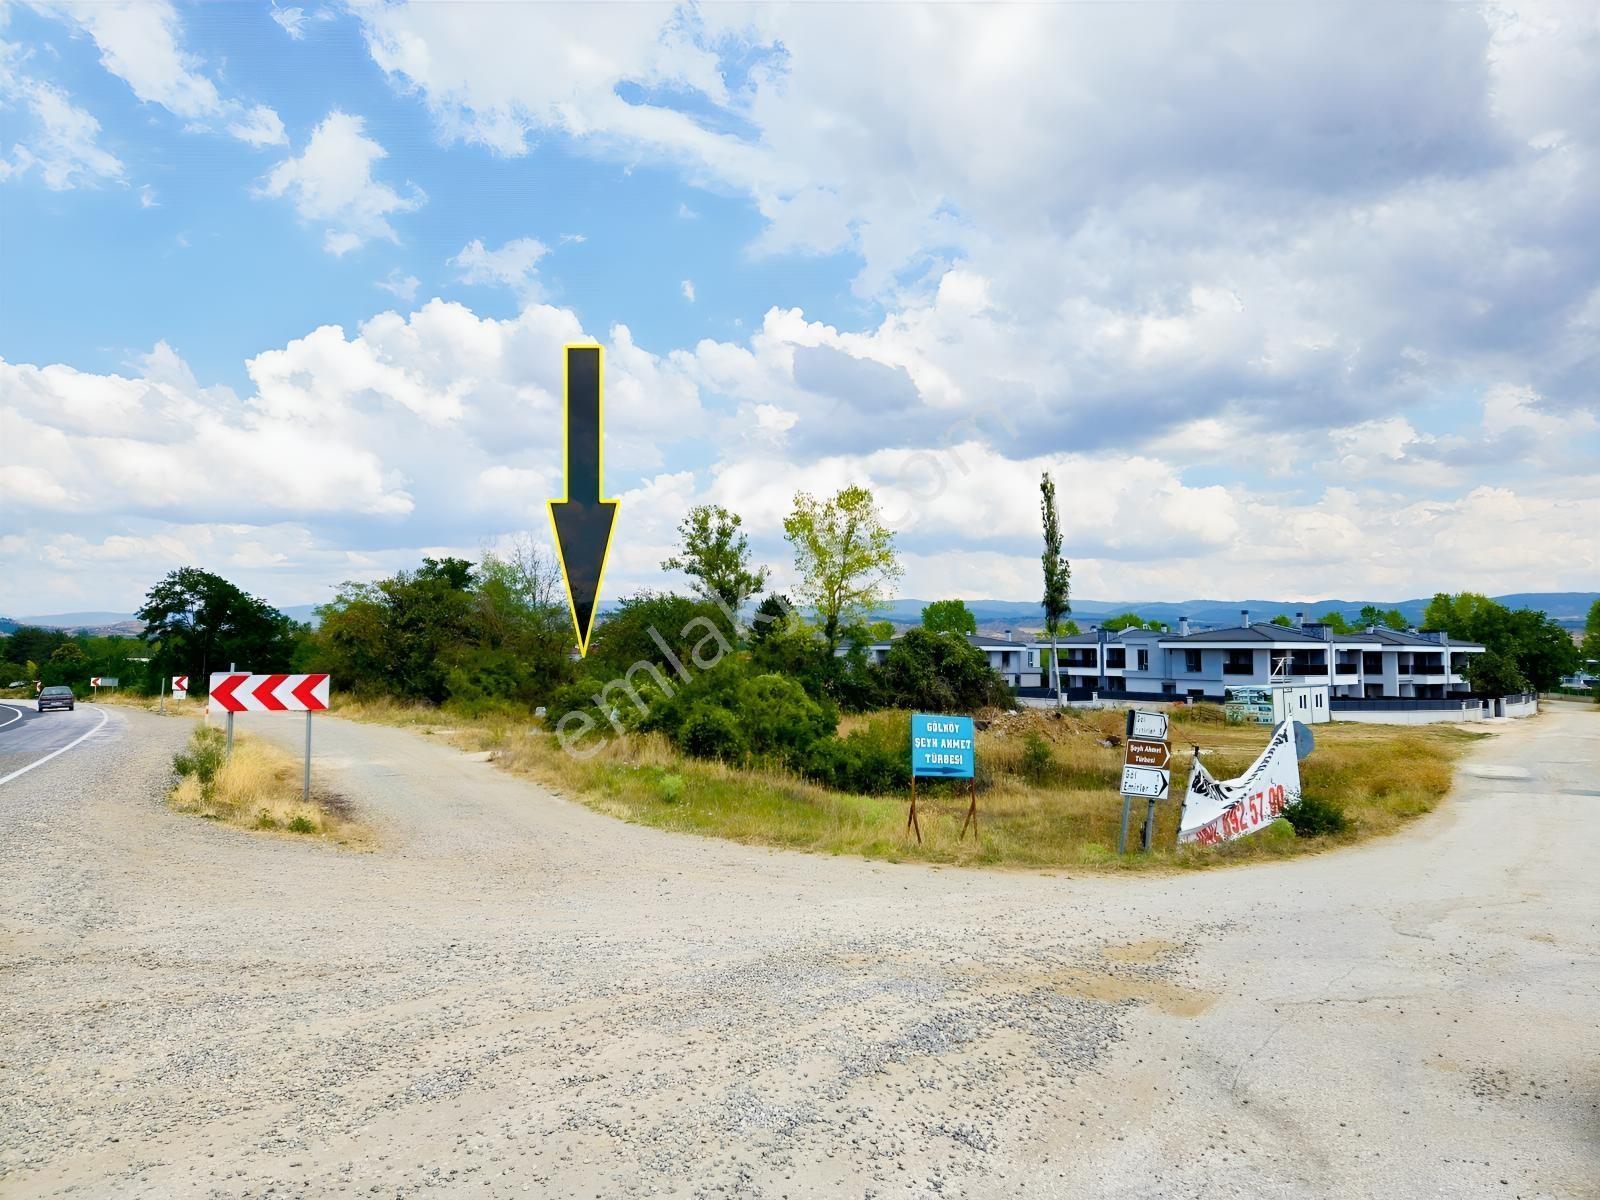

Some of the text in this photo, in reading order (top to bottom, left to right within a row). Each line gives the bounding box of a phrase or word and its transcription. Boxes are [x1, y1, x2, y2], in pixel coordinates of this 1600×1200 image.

[927, 721, 959, 733] GÖLKÖY
[941, 739, 971, 749] AHMET
[1144, 745, 1162, 754] Ahmet
[1135, 755, 1156, 764] Türbesi
[1126, 769, 1137, 780] Göl
[1249, 792, 1264, 825] 57
